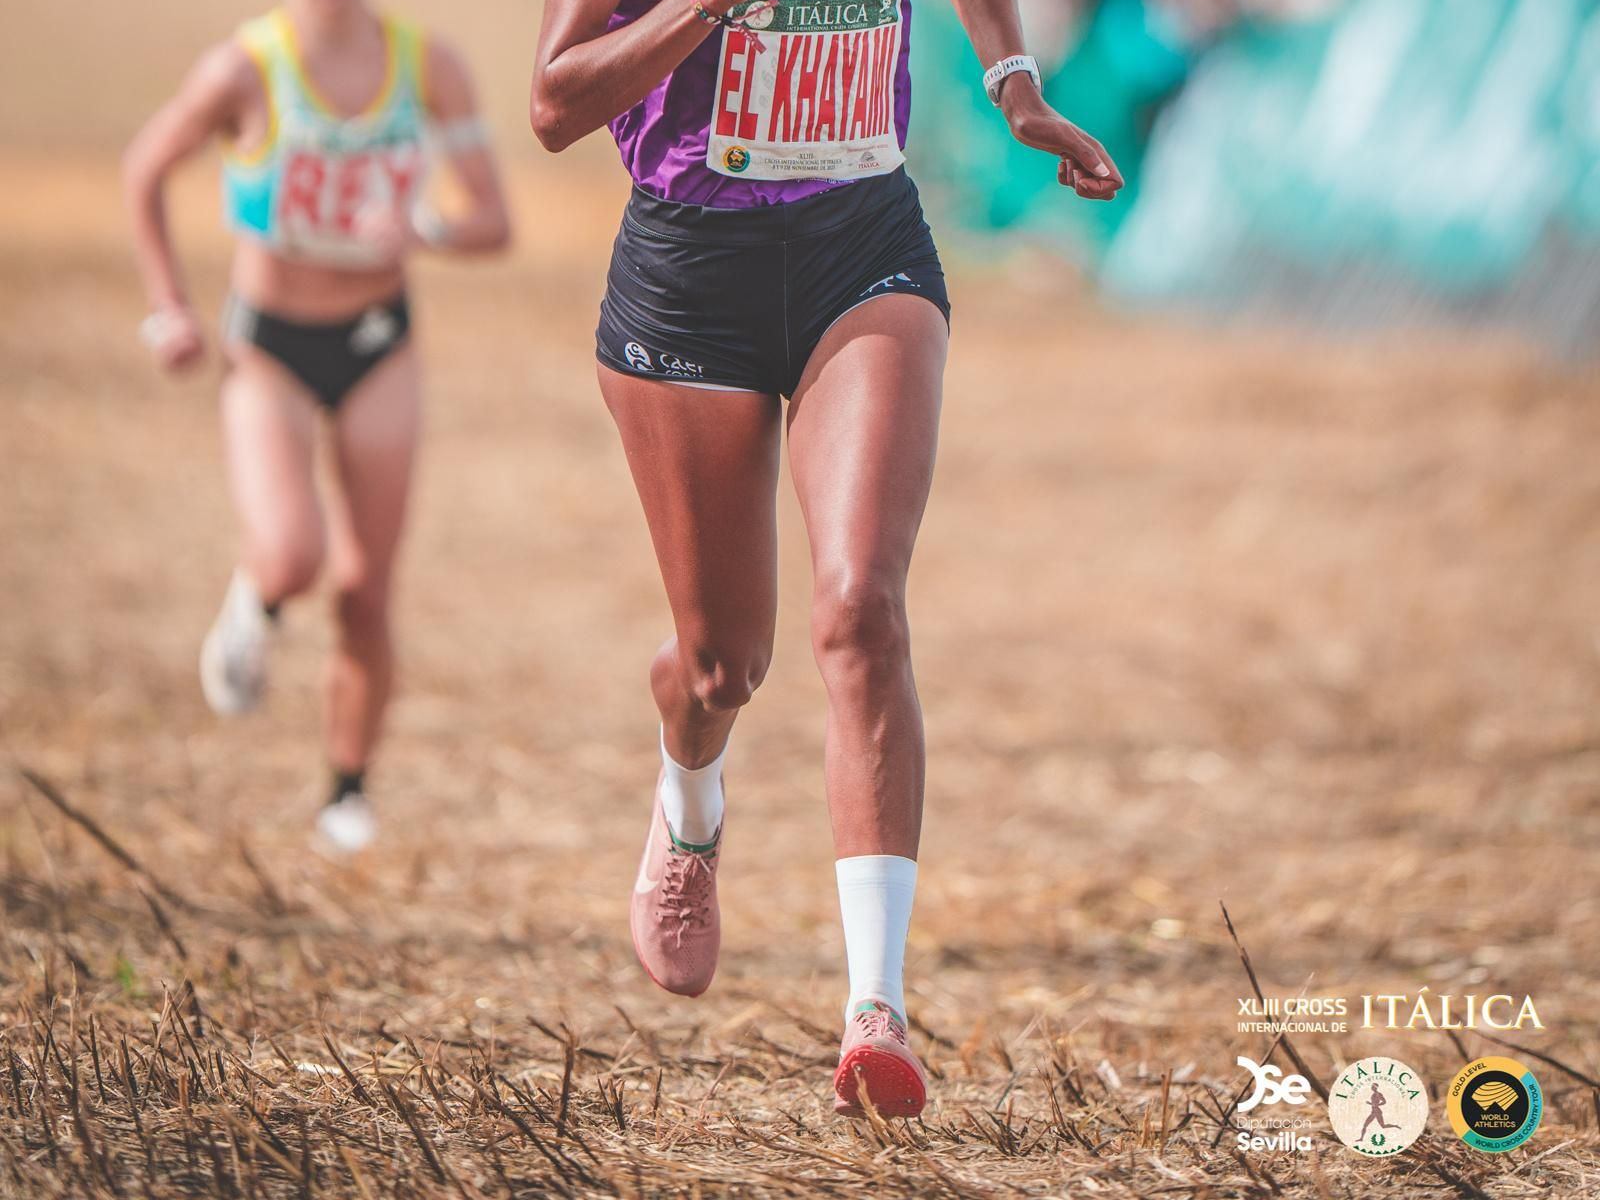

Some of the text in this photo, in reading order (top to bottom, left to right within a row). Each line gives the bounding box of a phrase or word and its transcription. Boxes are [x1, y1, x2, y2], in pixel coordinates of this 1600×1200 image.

[787, 1, 869, 26] ITÁLICA
[715, 25, 897, 142] EL KHAYAMI
